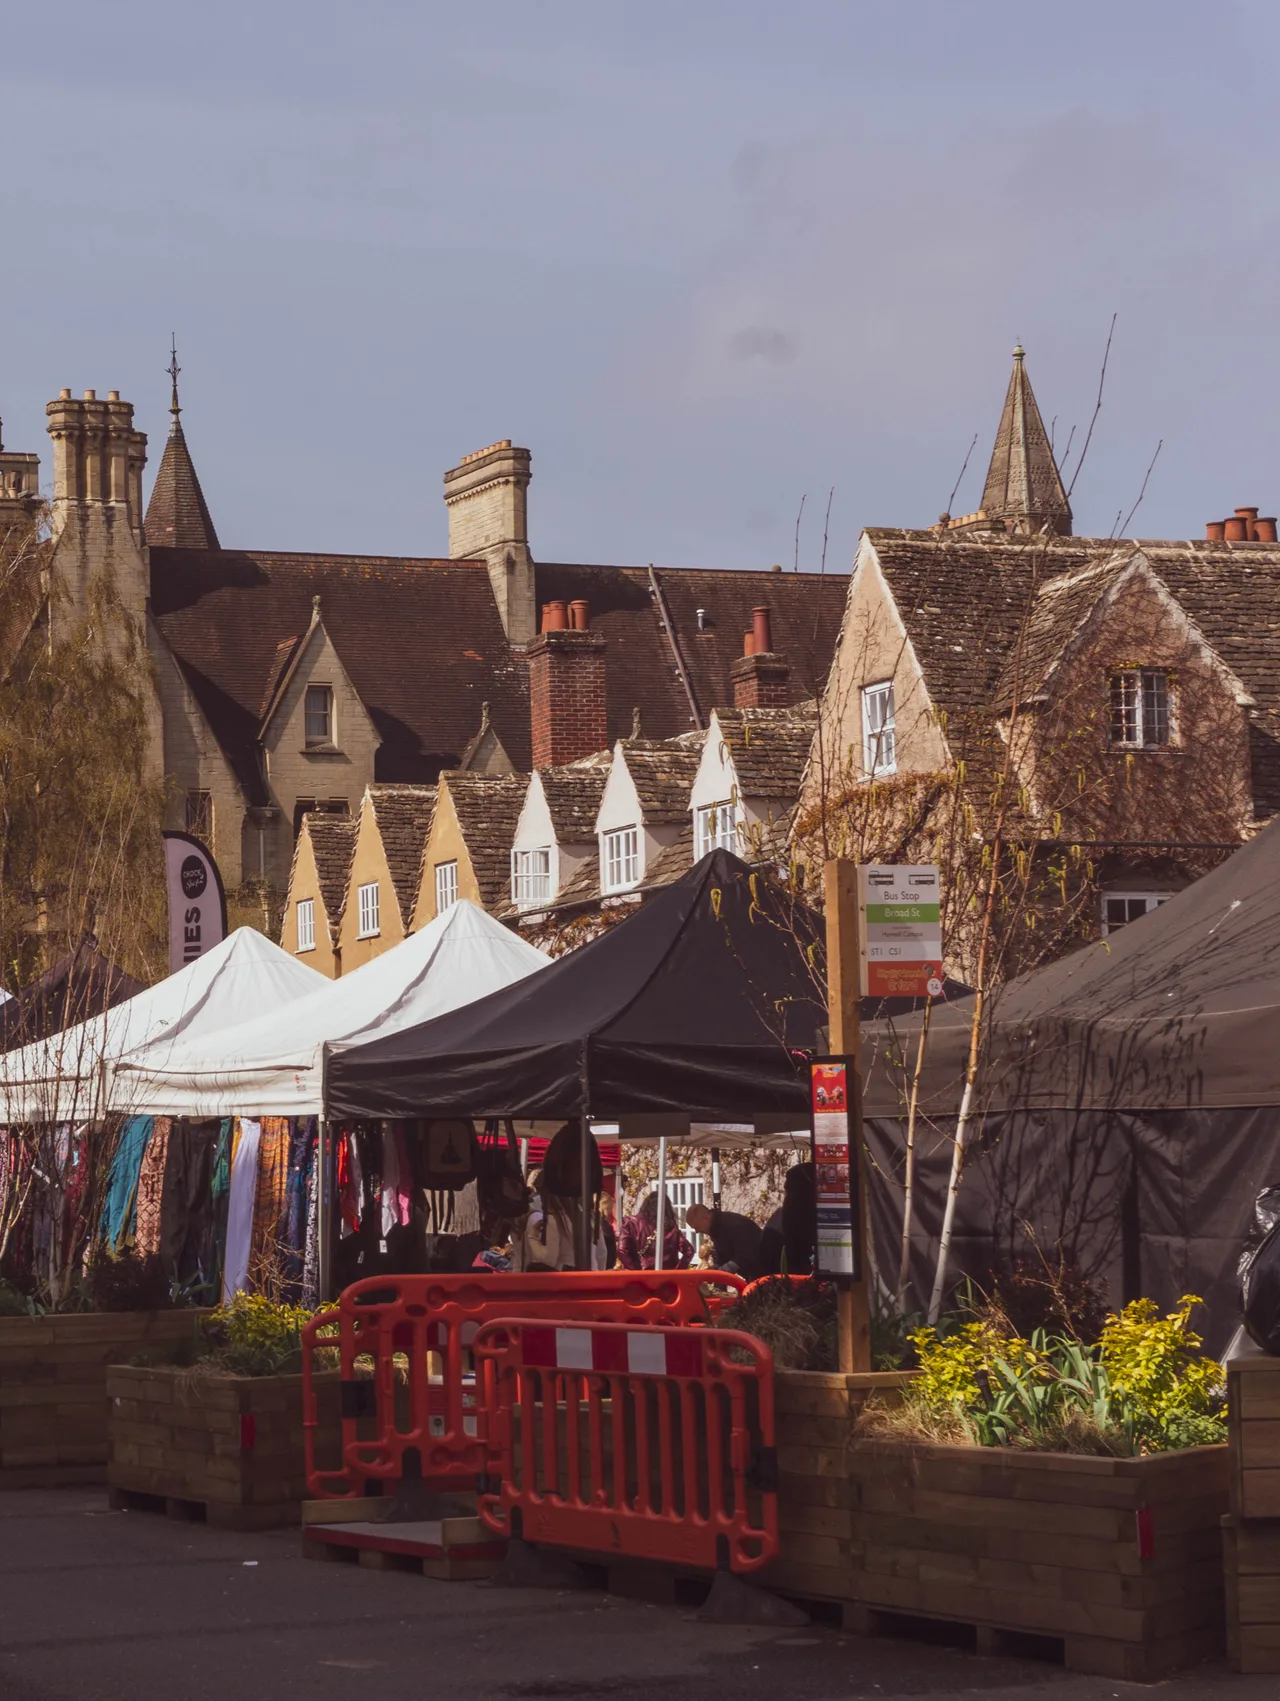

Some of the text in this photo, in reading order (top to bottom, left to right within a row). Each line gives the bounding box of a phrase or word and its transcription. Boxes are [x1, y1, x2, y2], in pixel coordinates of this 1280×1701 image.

[884, 891, 919, 902] Bus Stop
[884, 907, 920, 917] Broad St
